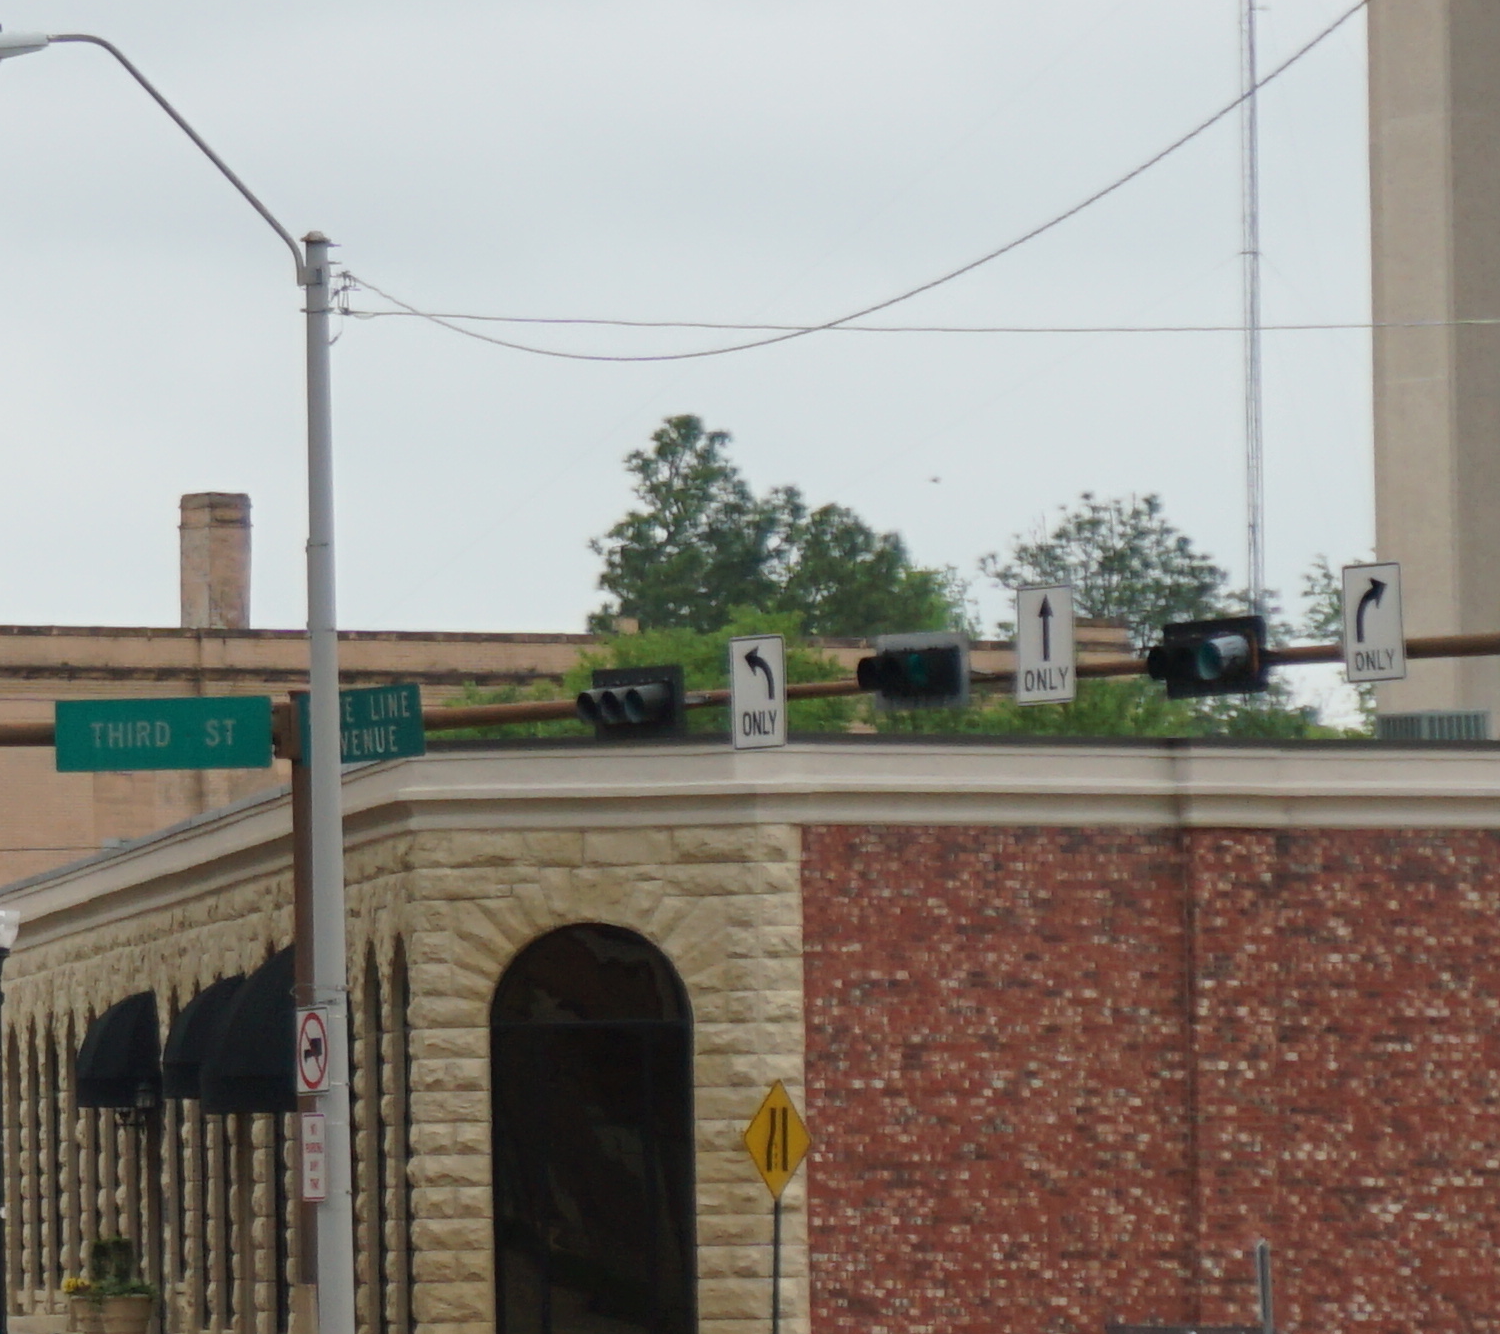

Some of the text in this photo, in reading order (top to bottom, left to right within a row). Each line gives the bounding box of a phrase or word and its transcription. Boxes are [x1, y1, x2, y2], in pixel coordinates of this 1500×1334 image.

[1354, 648, 1395, 672] ONLY
[1024, 667, 1069, 692] ONLY
[370, 690, 411, 721] LINE
[90, 718, 237, 749] THIRD ST
[742, 710, 777, 737] ONLY
[340, 725, 399, 756] VENUE
